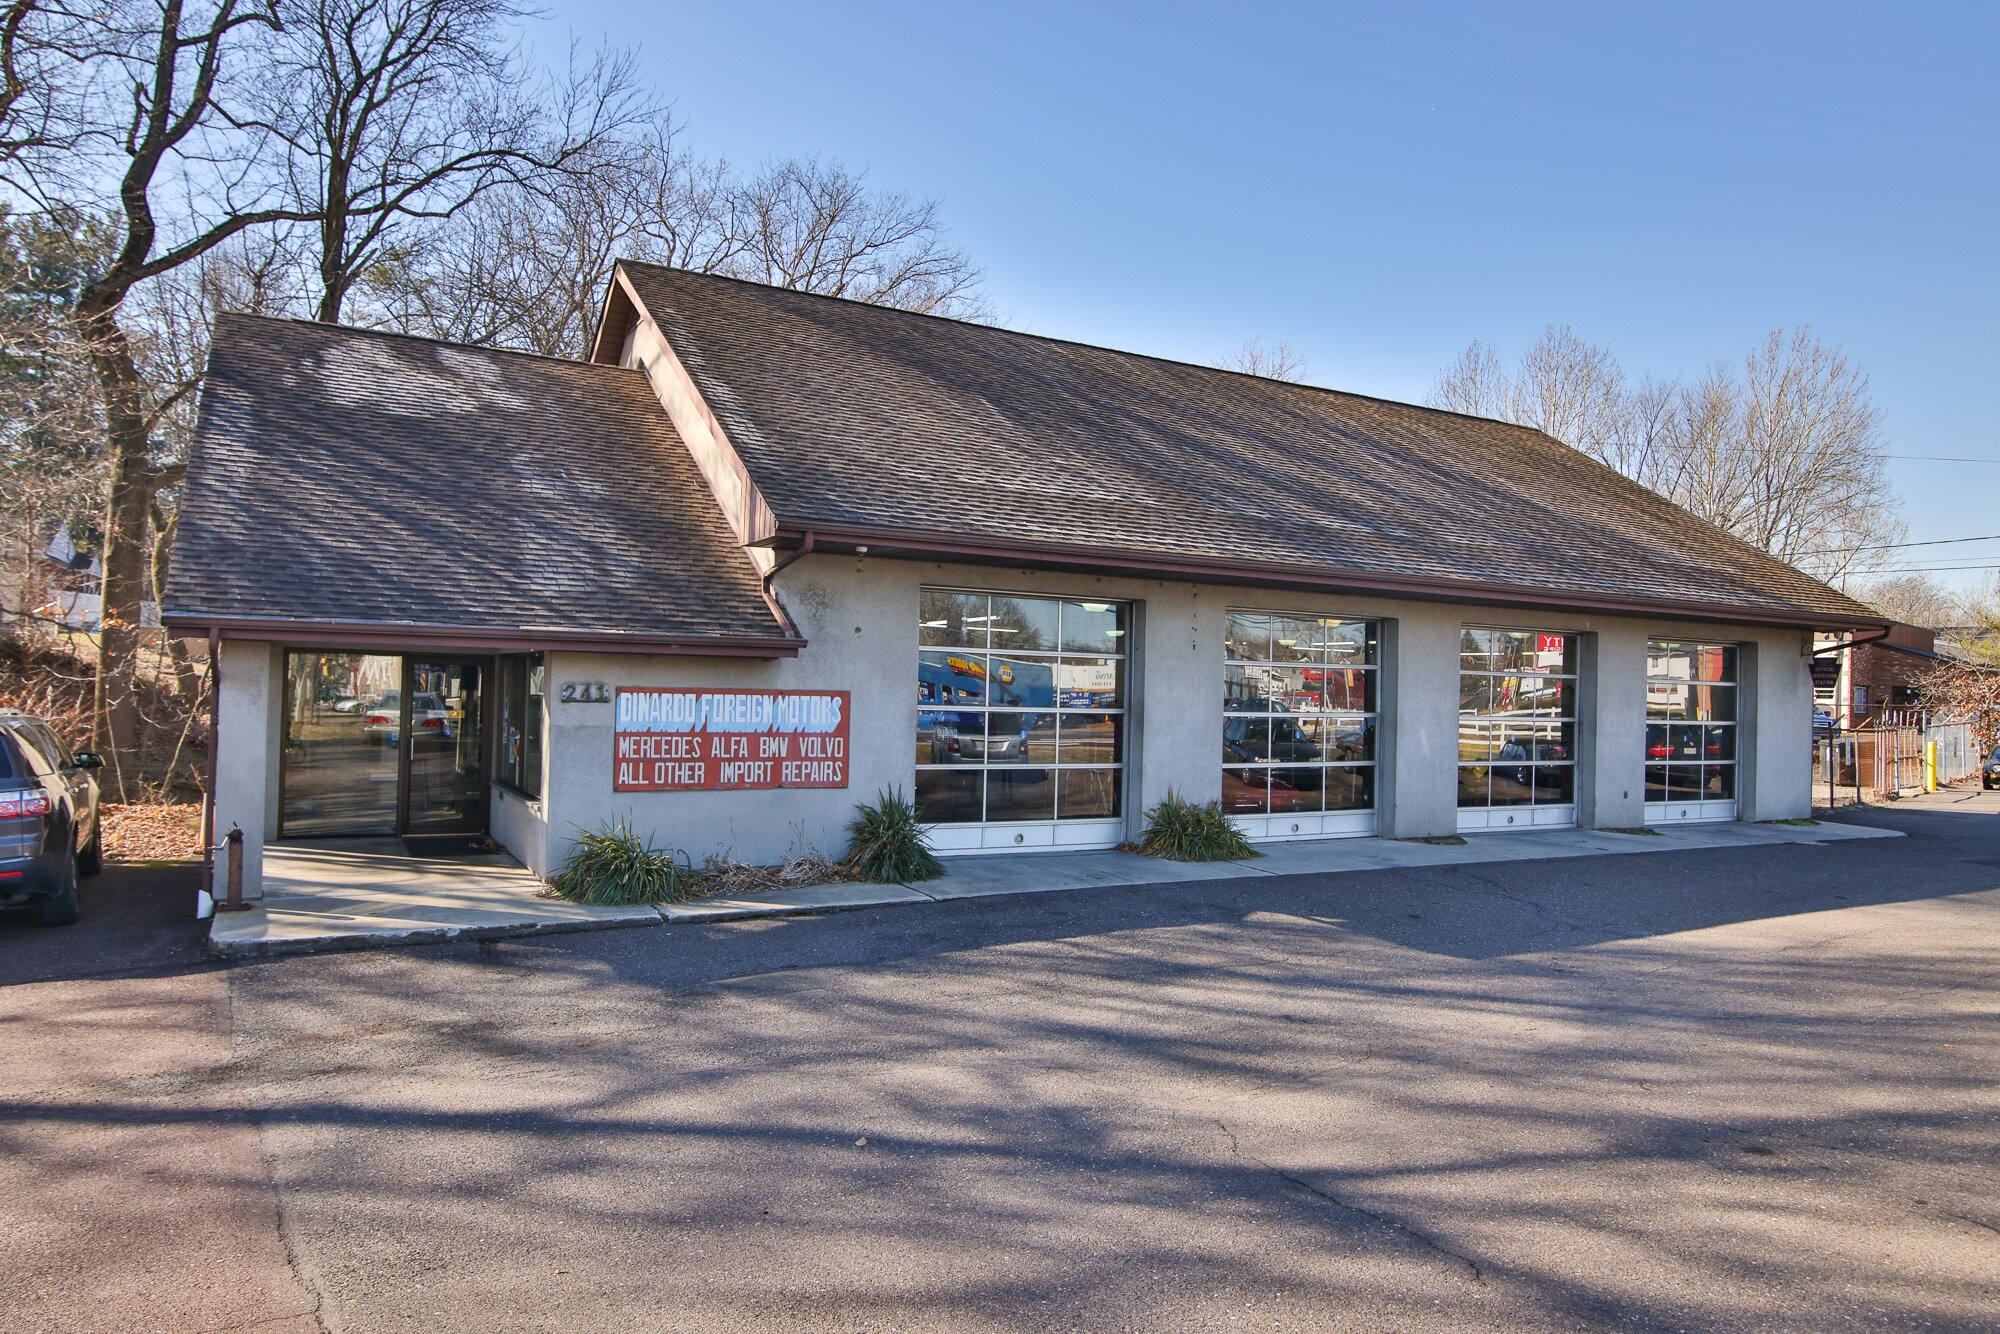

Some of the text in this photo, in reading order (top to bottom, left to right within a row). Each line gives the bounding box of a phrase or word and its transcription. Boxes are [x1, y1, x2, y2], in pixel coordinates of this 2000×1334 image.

[562, 682, 604, 700] 241
[618, 692, 843, 725] DINARDO FOREIGN MOTORS
[619, 736, 844, 759] MERCEDES ALFA BMW VOLVO
[618, 761, 843, 785] ALL OTHER IMPORT REPAIRS
